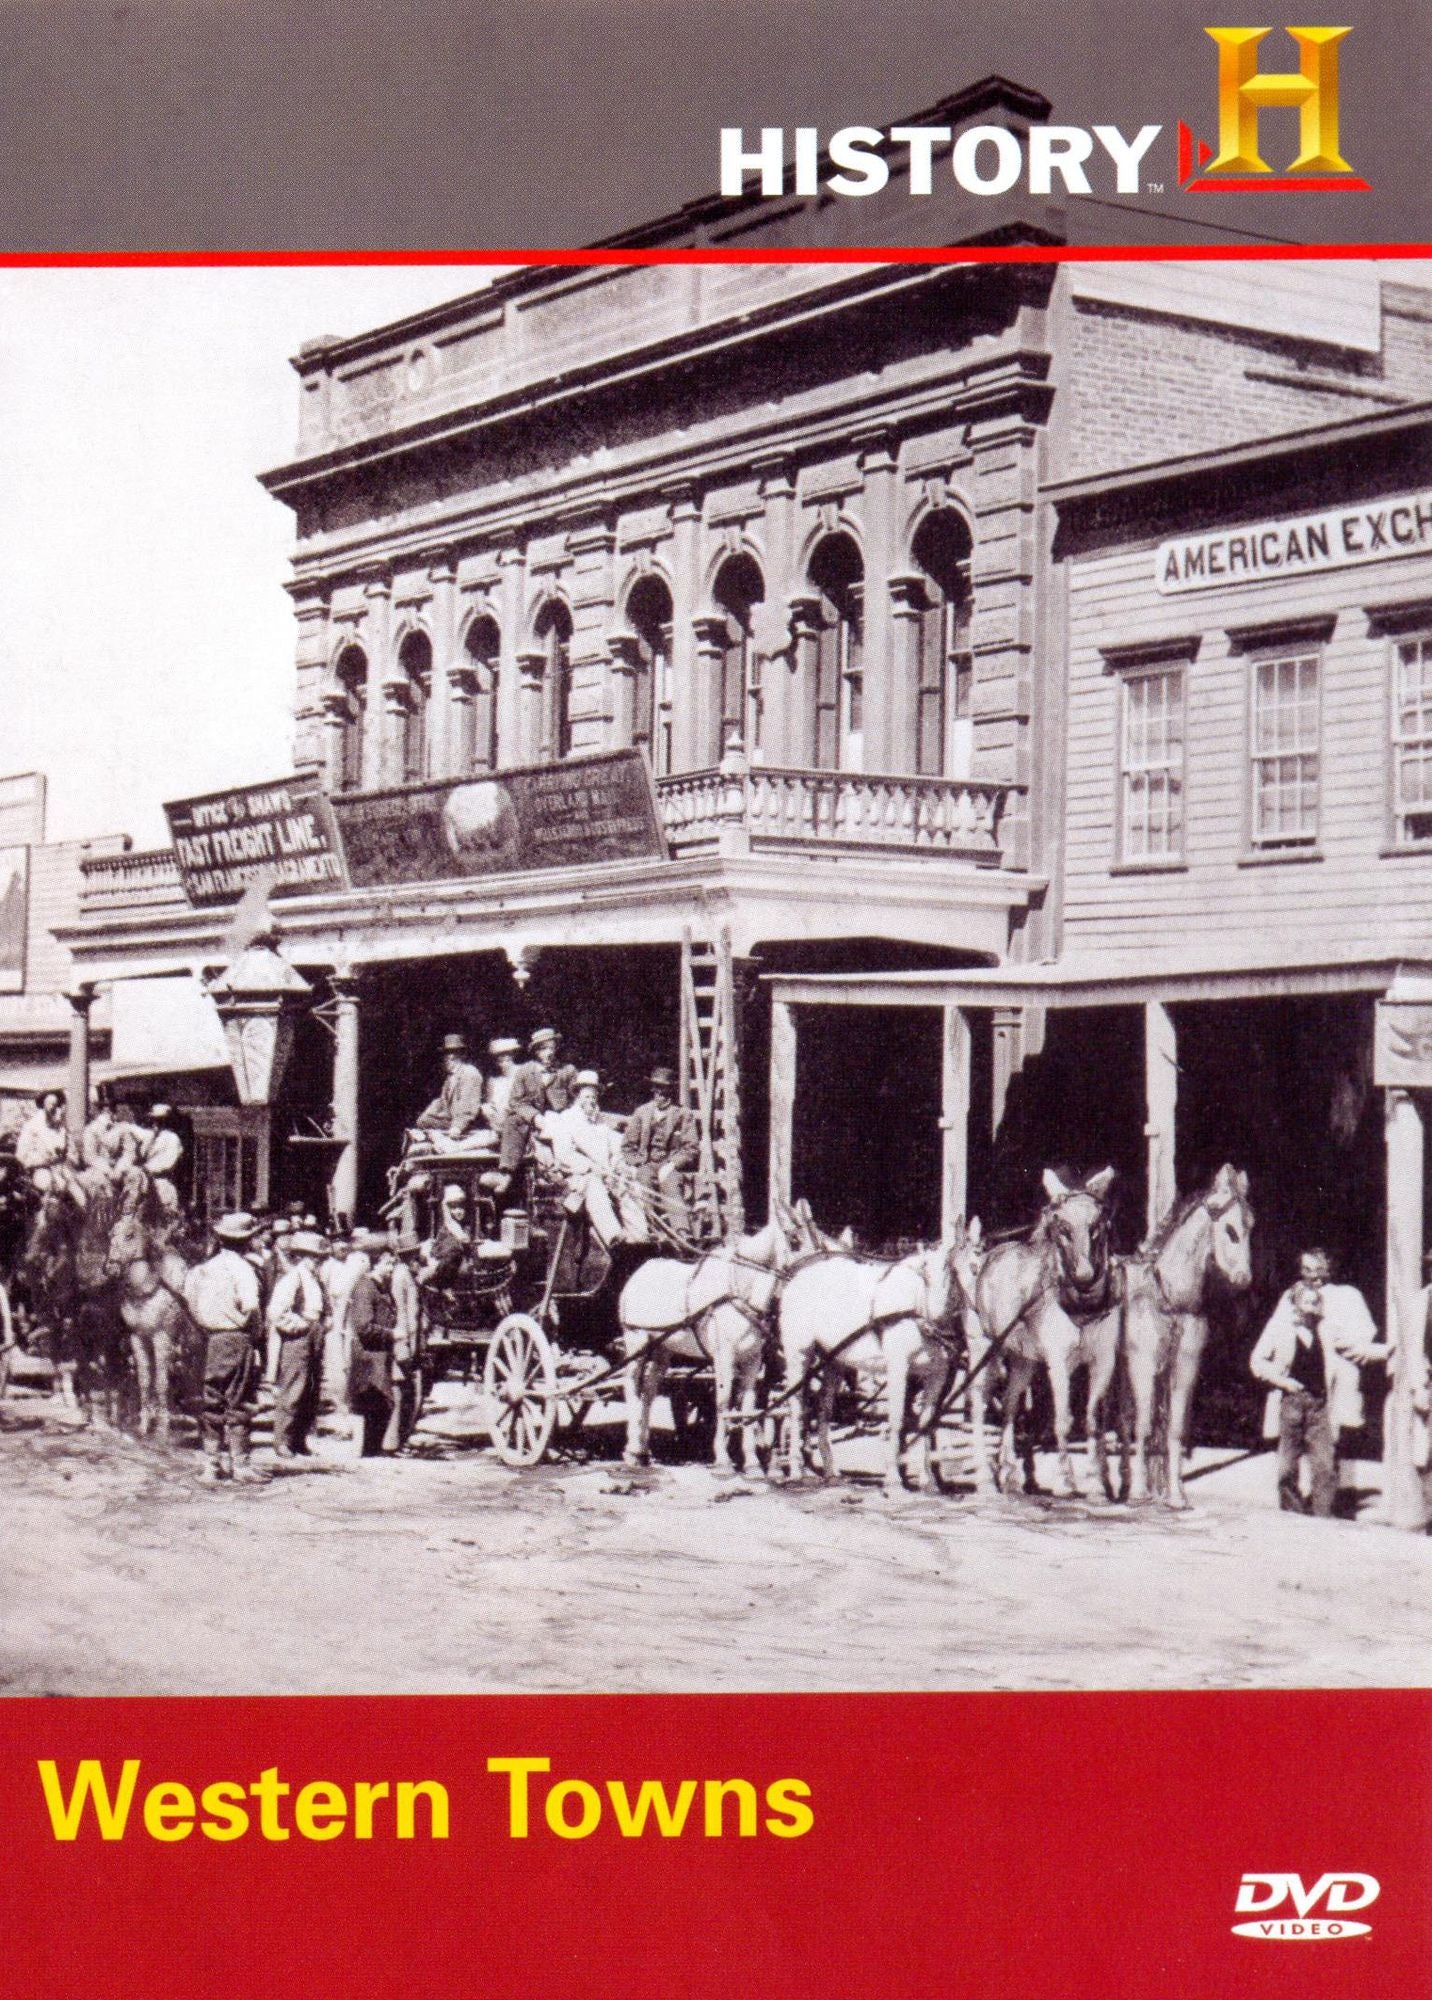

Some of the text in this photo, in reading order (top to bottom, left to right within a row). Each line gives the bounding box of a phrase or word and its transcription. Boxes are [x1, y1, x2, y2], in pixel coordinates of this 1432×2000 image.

[1163, 502, 1432, 582] AMERICAN EXCH
[176, 834, 212, 868] FAST
[211, 822, 275, 864] FREIGHT
